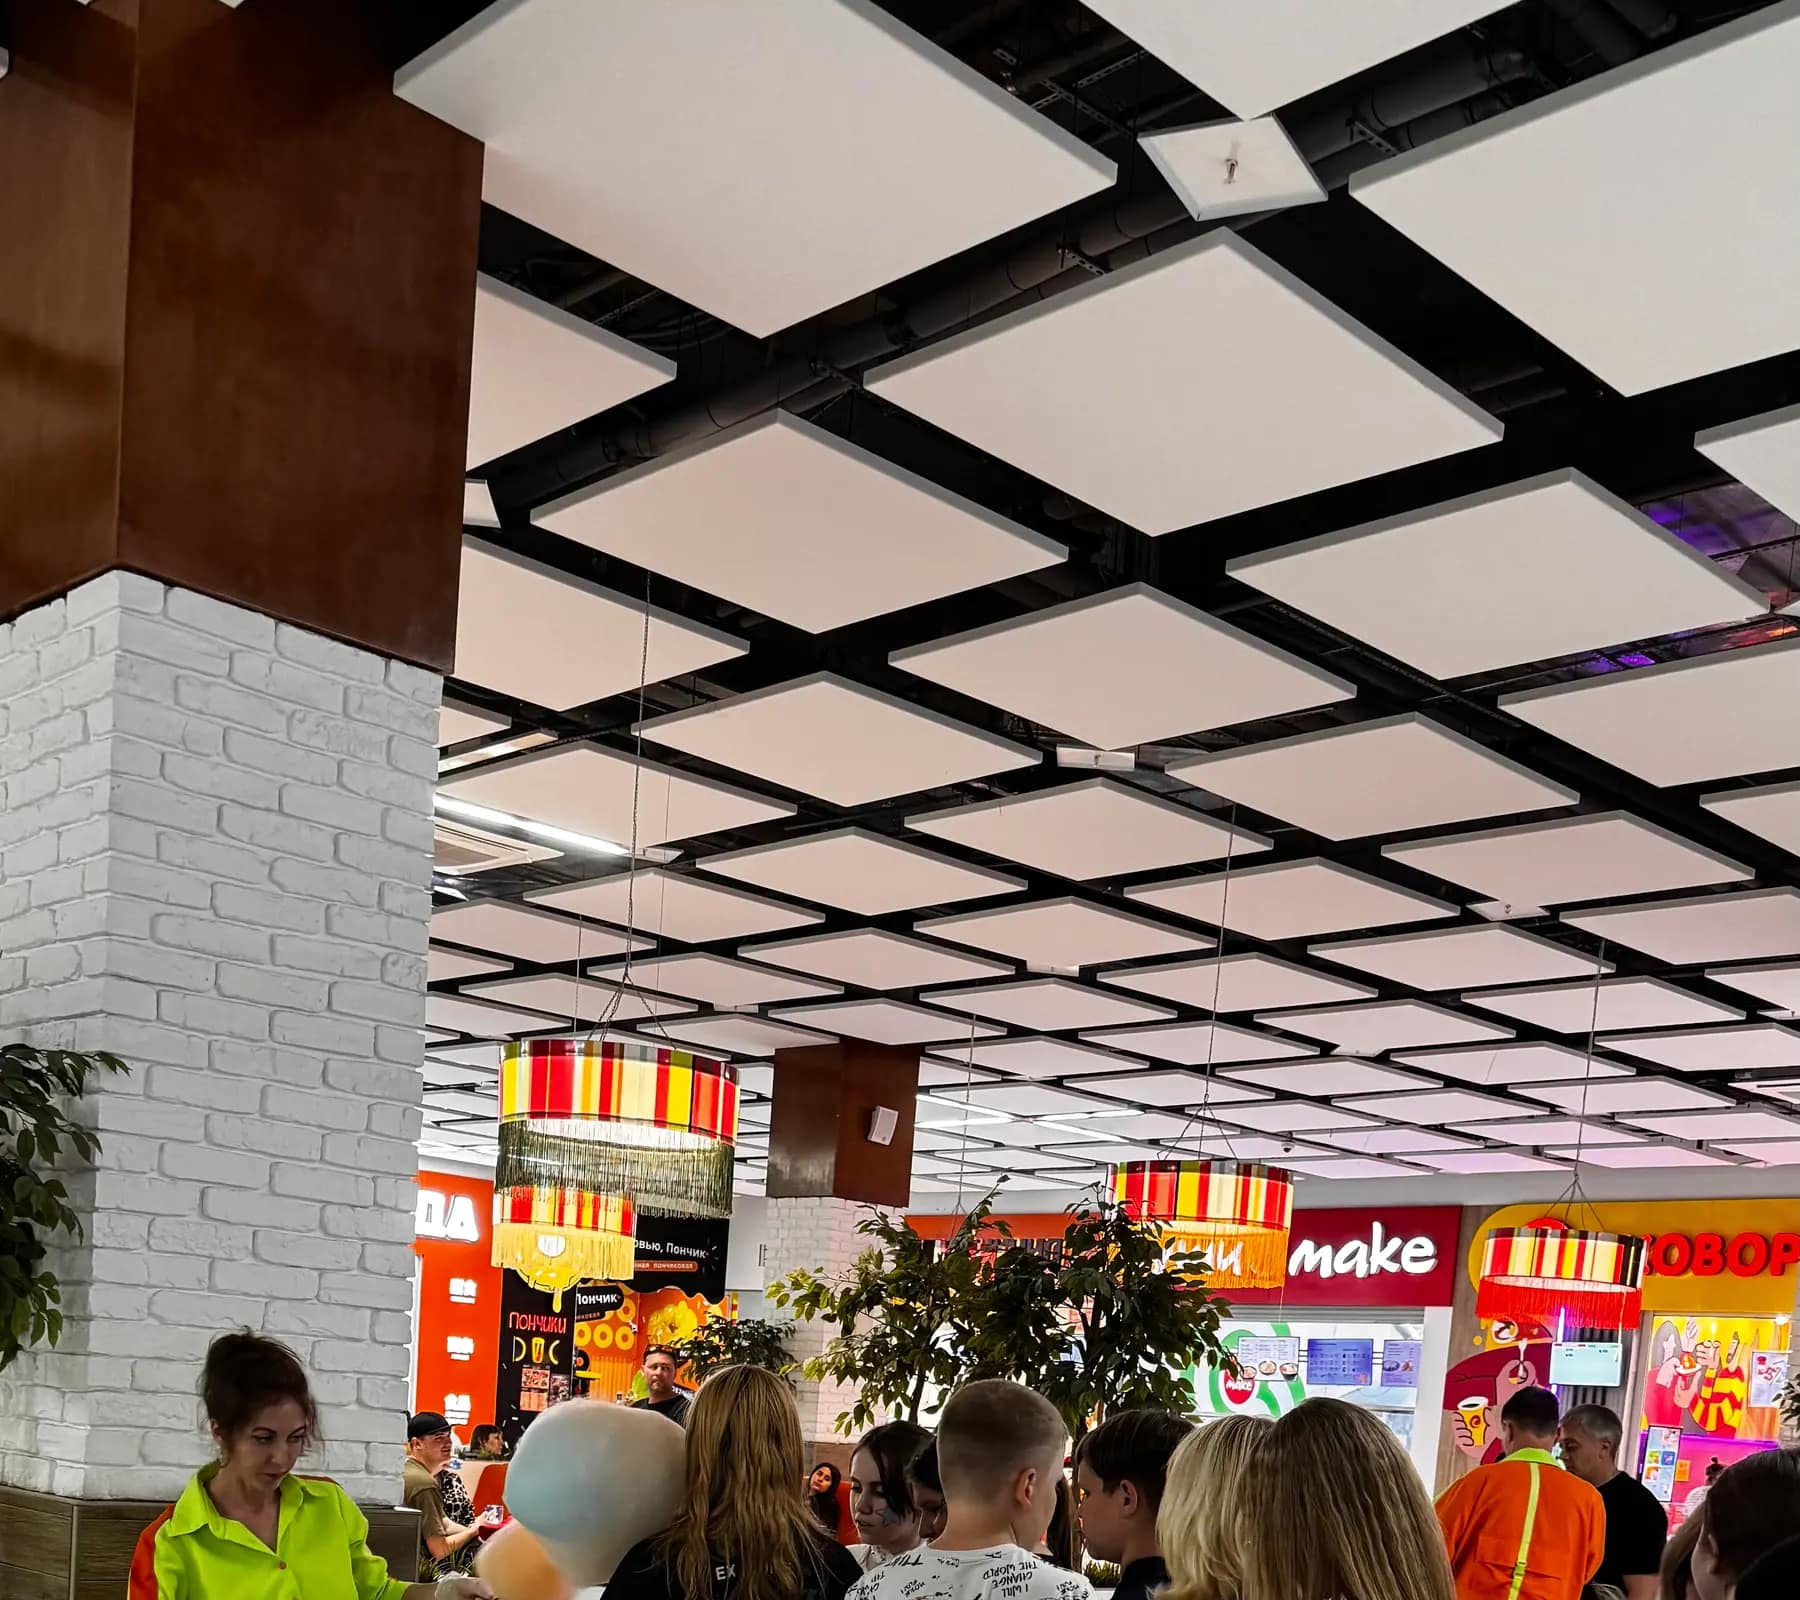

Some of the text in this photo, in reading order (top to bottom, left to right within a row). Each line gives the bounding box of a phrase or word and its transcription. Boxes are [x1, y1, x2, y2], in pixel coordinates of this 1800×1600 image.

[666, 1242, 706, 1259] Пончик
[1288, 1221, 1438, 1279] make
[1643, 1232, 1800, 1277] ОВОР
